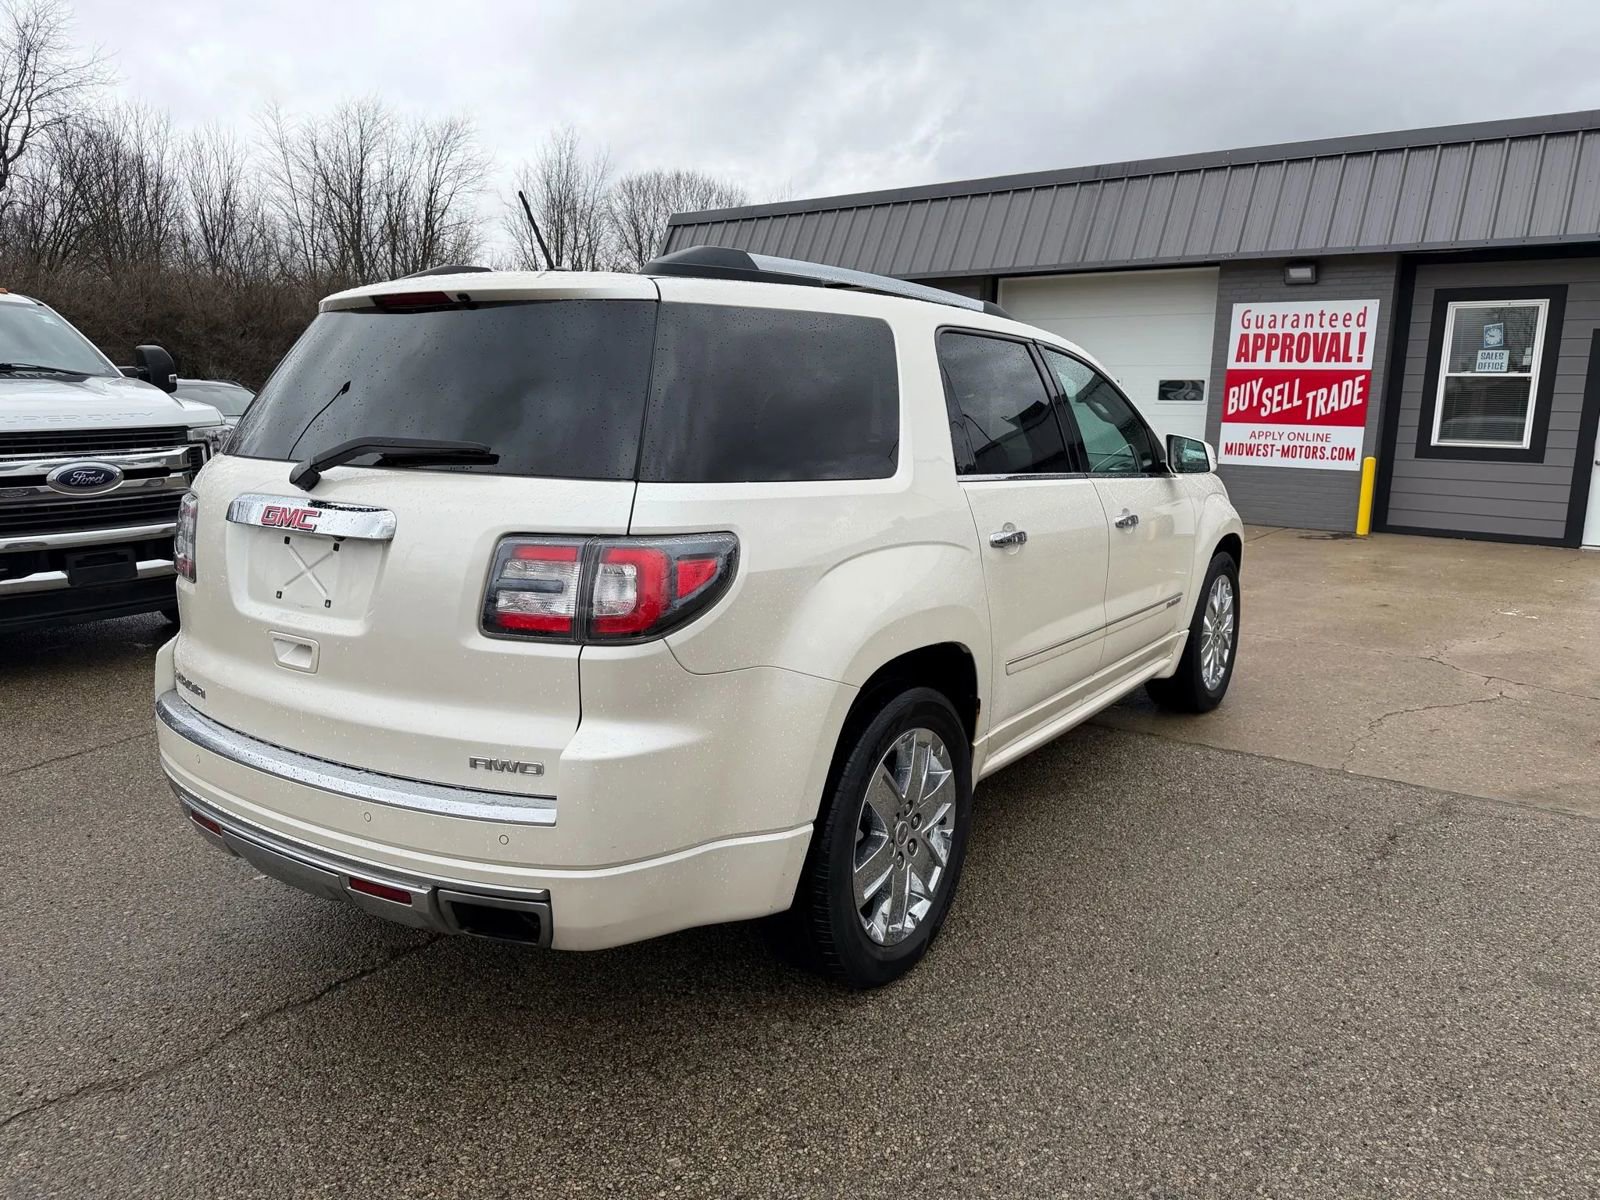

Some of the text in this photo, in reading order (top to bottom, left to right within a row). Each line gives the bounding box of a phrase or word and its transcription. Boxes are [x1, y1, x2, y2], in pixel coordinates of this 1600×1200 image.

[1241, 306, 1368, 330] Guaranteed
[1235, 332, 1367, 363] APPROVAL!
[1481, 352, 1504, 360] SALES
[1478, 362, 1504, 370] OFFICE
[1227, 374, 1366, 420] BUY SELL TRADE
[0, 414, 80, 424] UPER
[1249, 430, 1332, 443] APPLY ONLINE
[1224, 442, 1355, 461] MIDWEST-MOTORS.COM
[70, 470, 105, 486] Ford
[261, 505, 322, 532] GMC
[469, 756, 544, 776] AWD
